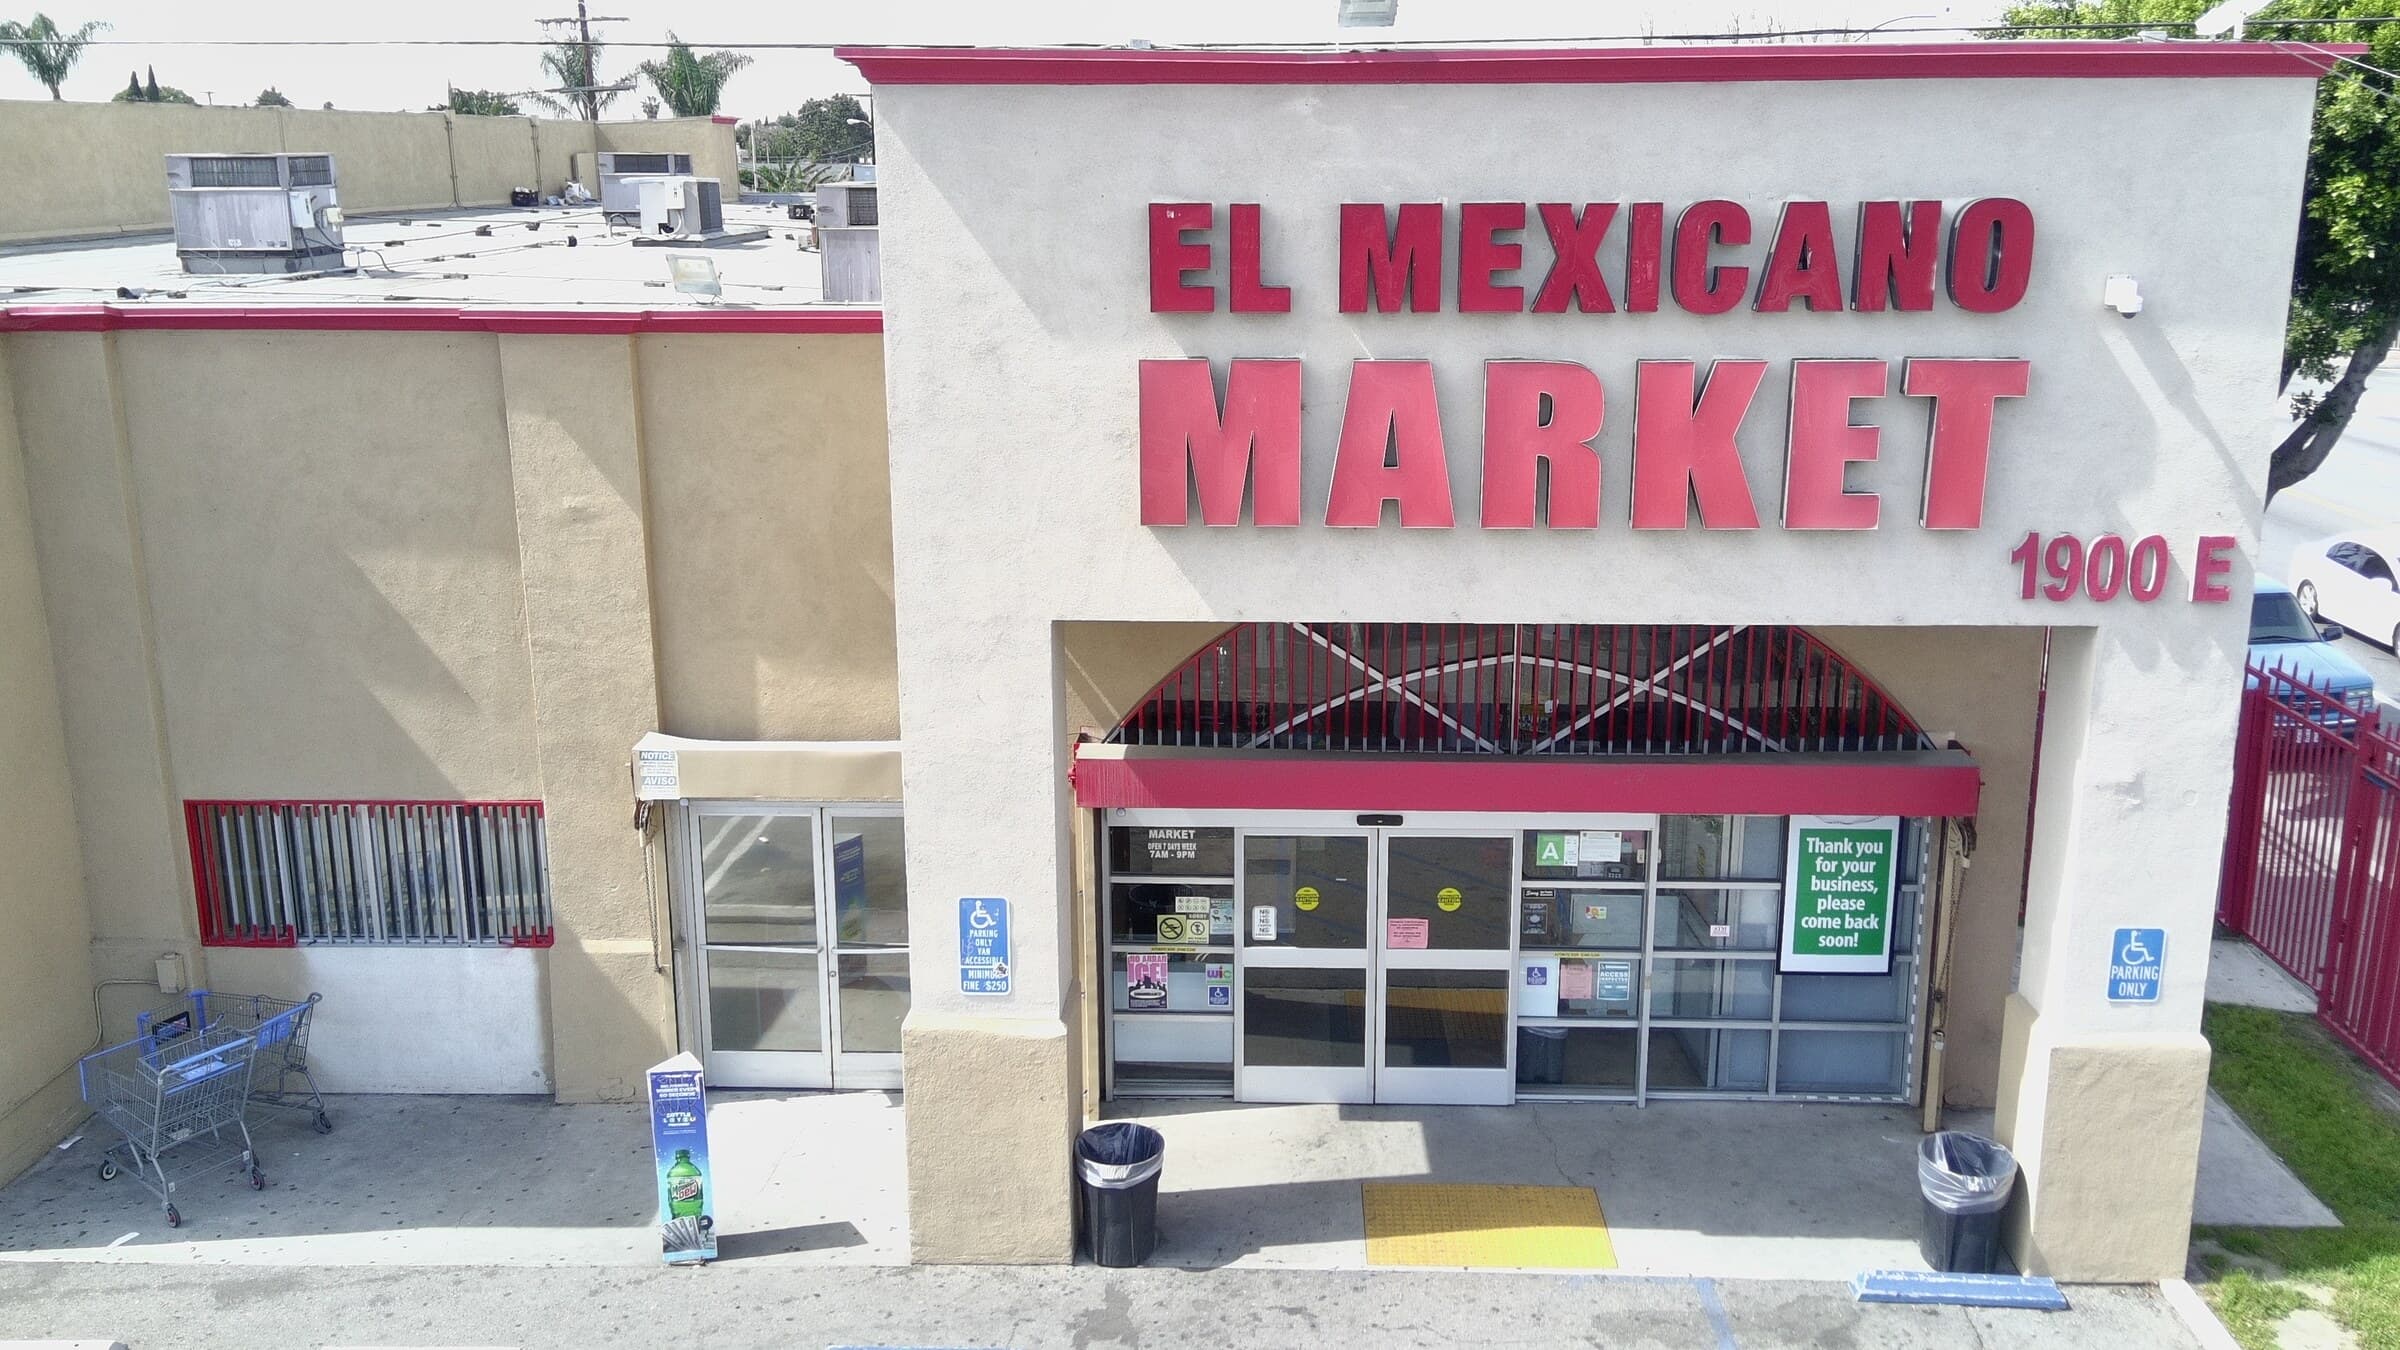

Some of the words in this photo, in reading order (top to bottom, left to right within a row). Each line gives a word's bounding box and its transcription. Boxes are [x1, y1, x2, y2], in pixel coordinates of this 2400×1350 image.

[1148, 202, 1291, 312] EL
[1338, 198, 2034, 313] MEXICANO
[1140, 357, 2030, 530] MARKET
[2011, 531, 2169, 601] 1900
[2188, 534, 2236, 602] E
[641, 751, 674, 760] NOTICE
[644, 776, 675, 785] AVISO
[1149, 829, 1196, 839] MARKET
[1147, 842, 1163, 851] OPEN
[1168, 842, 1181, 851] DAYS
[1181, 842, 1197, 851] WEEK
[1541, 842, 1559, 860] A
[1806, 837, 1853, 854] Thank
[1856, 841, 1883, 858] you
[1150, 850, 1168, 858] 7AM
[1176, 850, 1195, 858] 9PM
[1815, 856, 1838, 873] for
[1842, 860, 1876, 877] your
[1811, 875, 1878, 894] business,
[1817, 894, 1866, 914] please
[1801, 916, 1842, 929] come
[1844, 913, 1879, 929] back
[969, 929, 999, 938] PARKING
[1818, 932, 1859, 948] soon!
[975, 938, 993, 947] ONLY
[977, 947, 991, 956] VAN
[1207, 965, 1232, 979] wic
[2111, 965, 2158, 980] PARKING
[963, 980, 980, 991] FINE
[985, 980, 1007, 991] $250
[2118, 982, 2148, 996] ONLY
